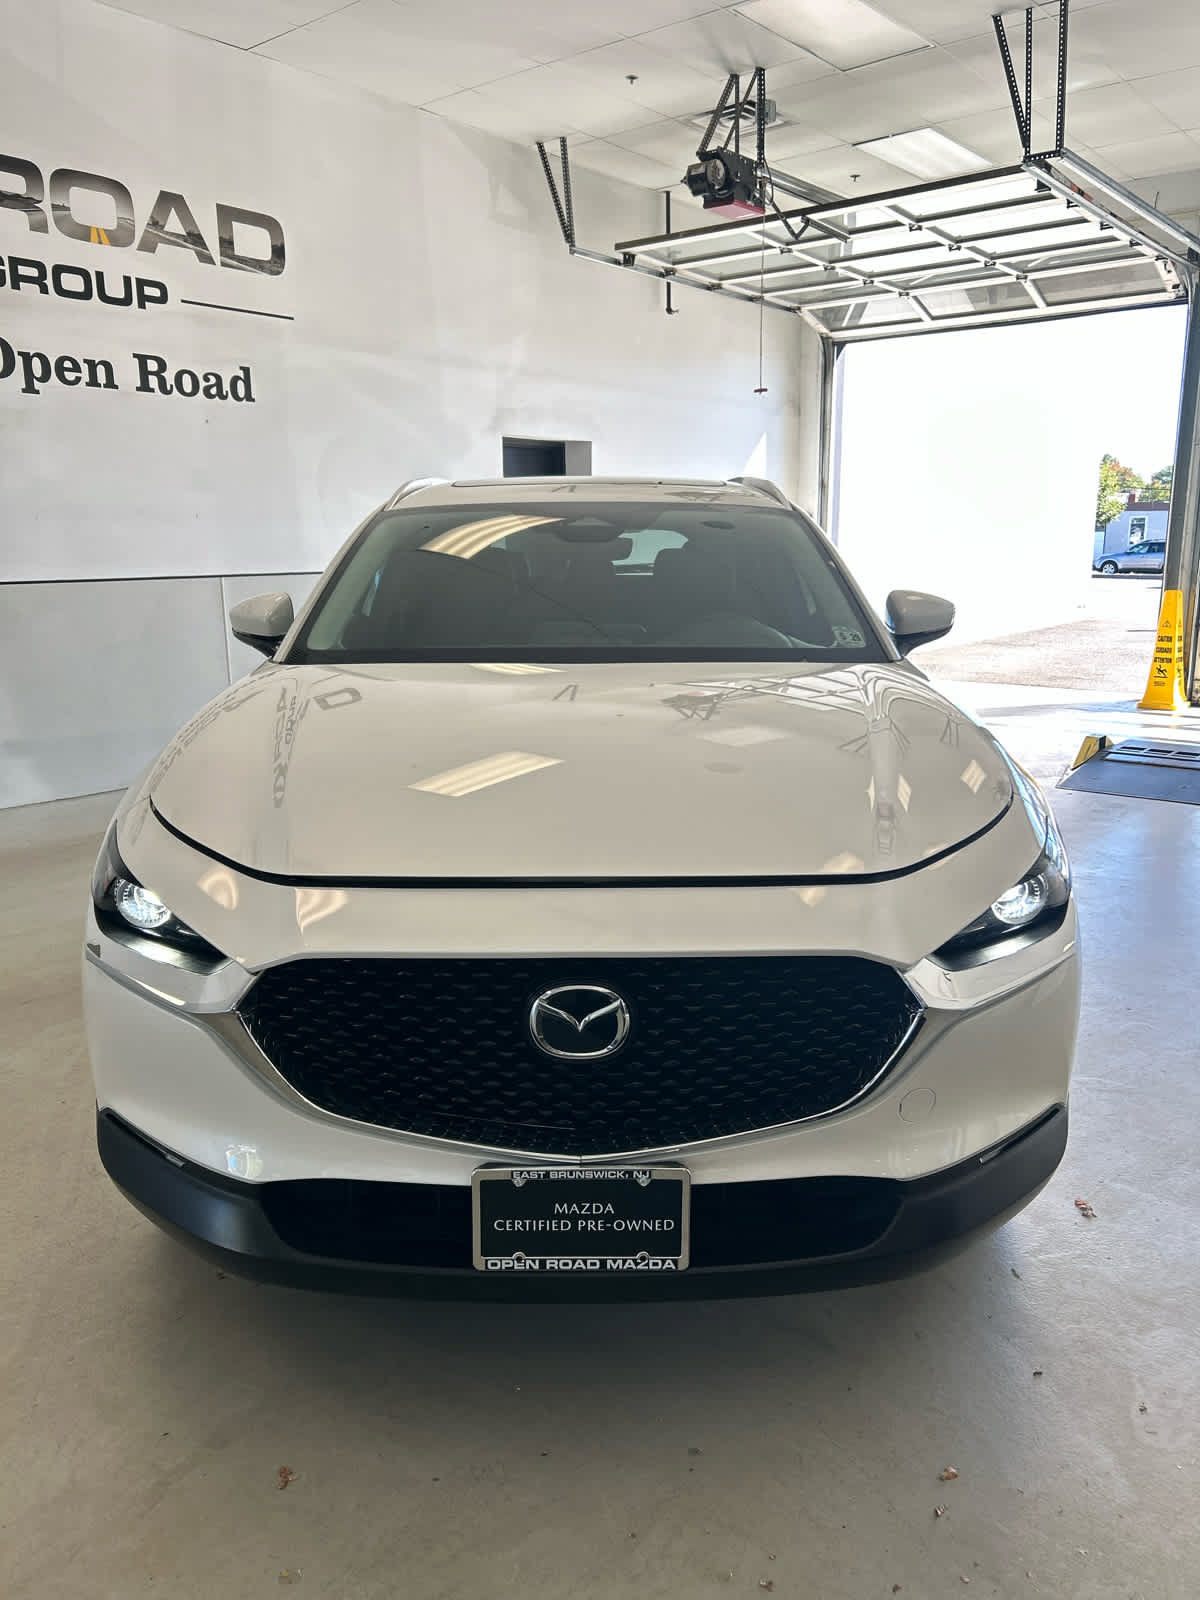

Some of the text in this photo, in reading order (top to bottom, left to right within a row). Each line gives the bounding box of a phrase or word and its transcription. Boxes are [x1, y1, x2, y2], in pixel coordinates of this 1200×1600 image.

[0, 255, 168, 309] ROUP
[133, 353, 255, 402] Road
[512, 1170, 650, 1179] EAST BRUNSWICK, NJ
[554, 1202, 615, 1215] MAZDA
[493, 1219, 675, 1231] CERTIFIED PRE-OWNED
[487, 1259, 539, 1270] OPEN
[546, 1259, 600, 1270] ROAD
